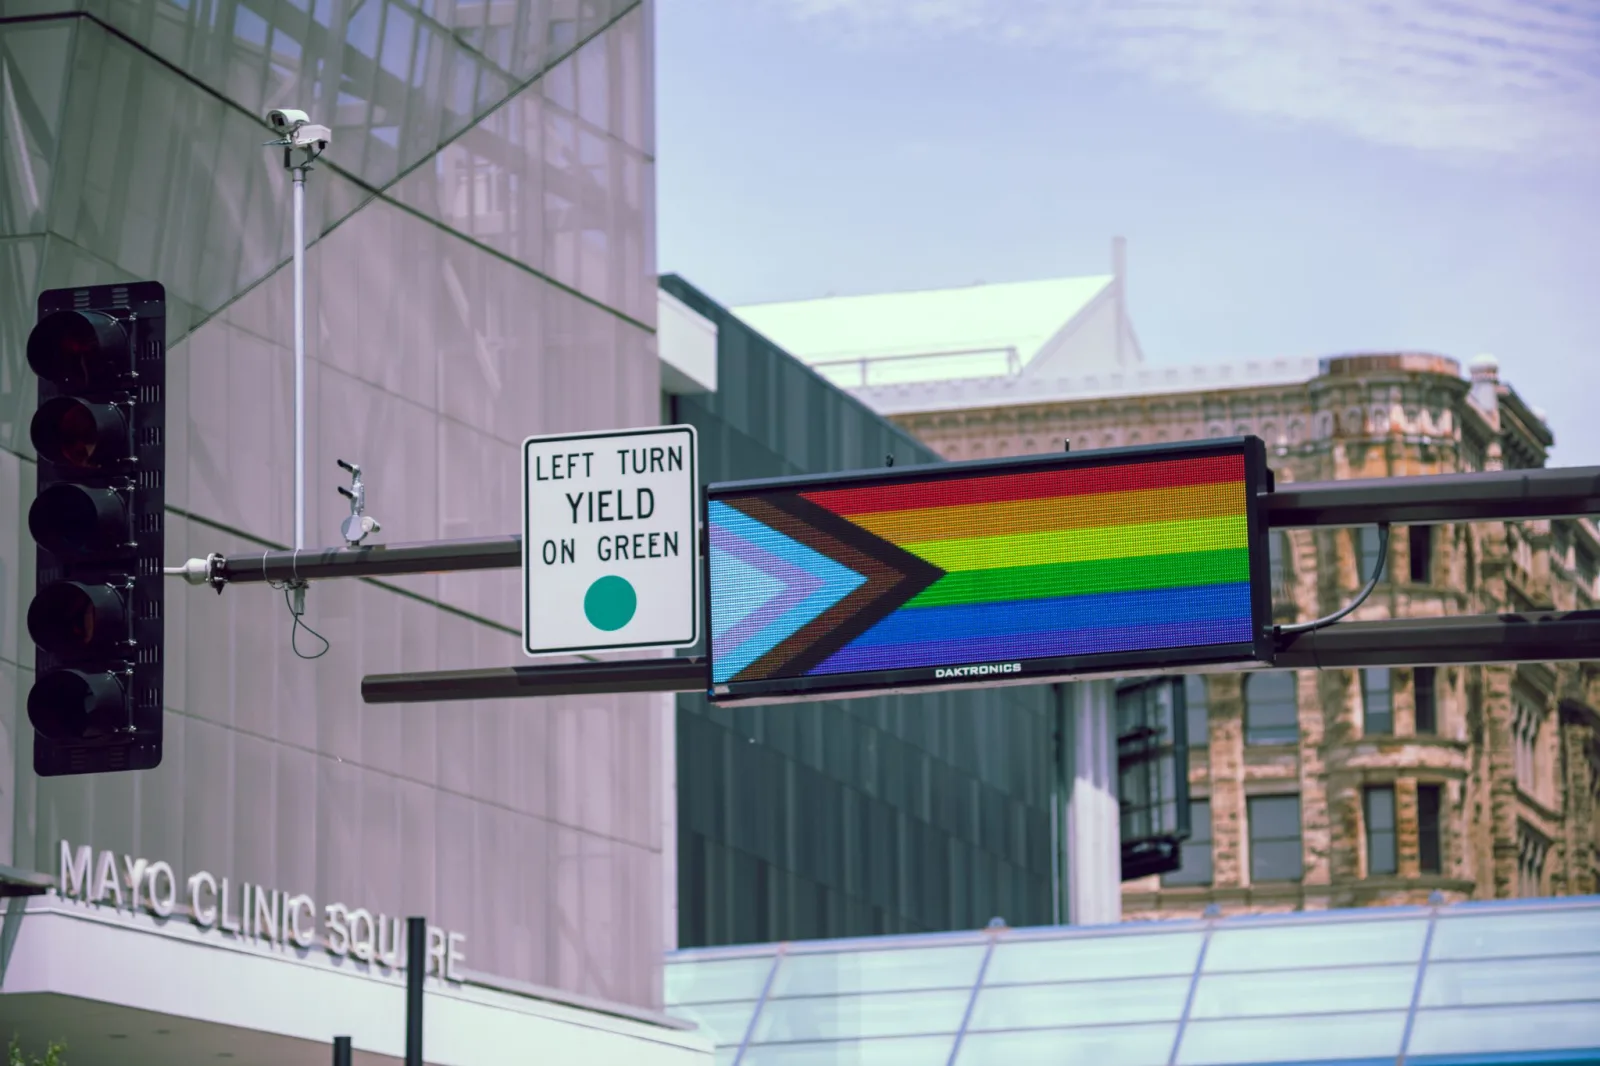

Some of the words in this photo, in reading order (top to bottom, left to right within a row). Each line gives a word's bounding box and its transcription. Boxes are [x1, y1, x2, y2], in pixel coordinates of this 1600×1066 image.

[536, 452, 594, 481] LEFT
[617, 445, 683, 475] TURN
[566, 488, 655, 524] YIELD
[542, 538, 576, 565] ON
[597, 531, 679, 562] GREEN
[935, 663, 1022, 678] DAKTRONICS
[59, 839, 177, 918] MAYO
[187, 871, 316, 950] CLINIC
[326, 902, 467, 984] SQURE
